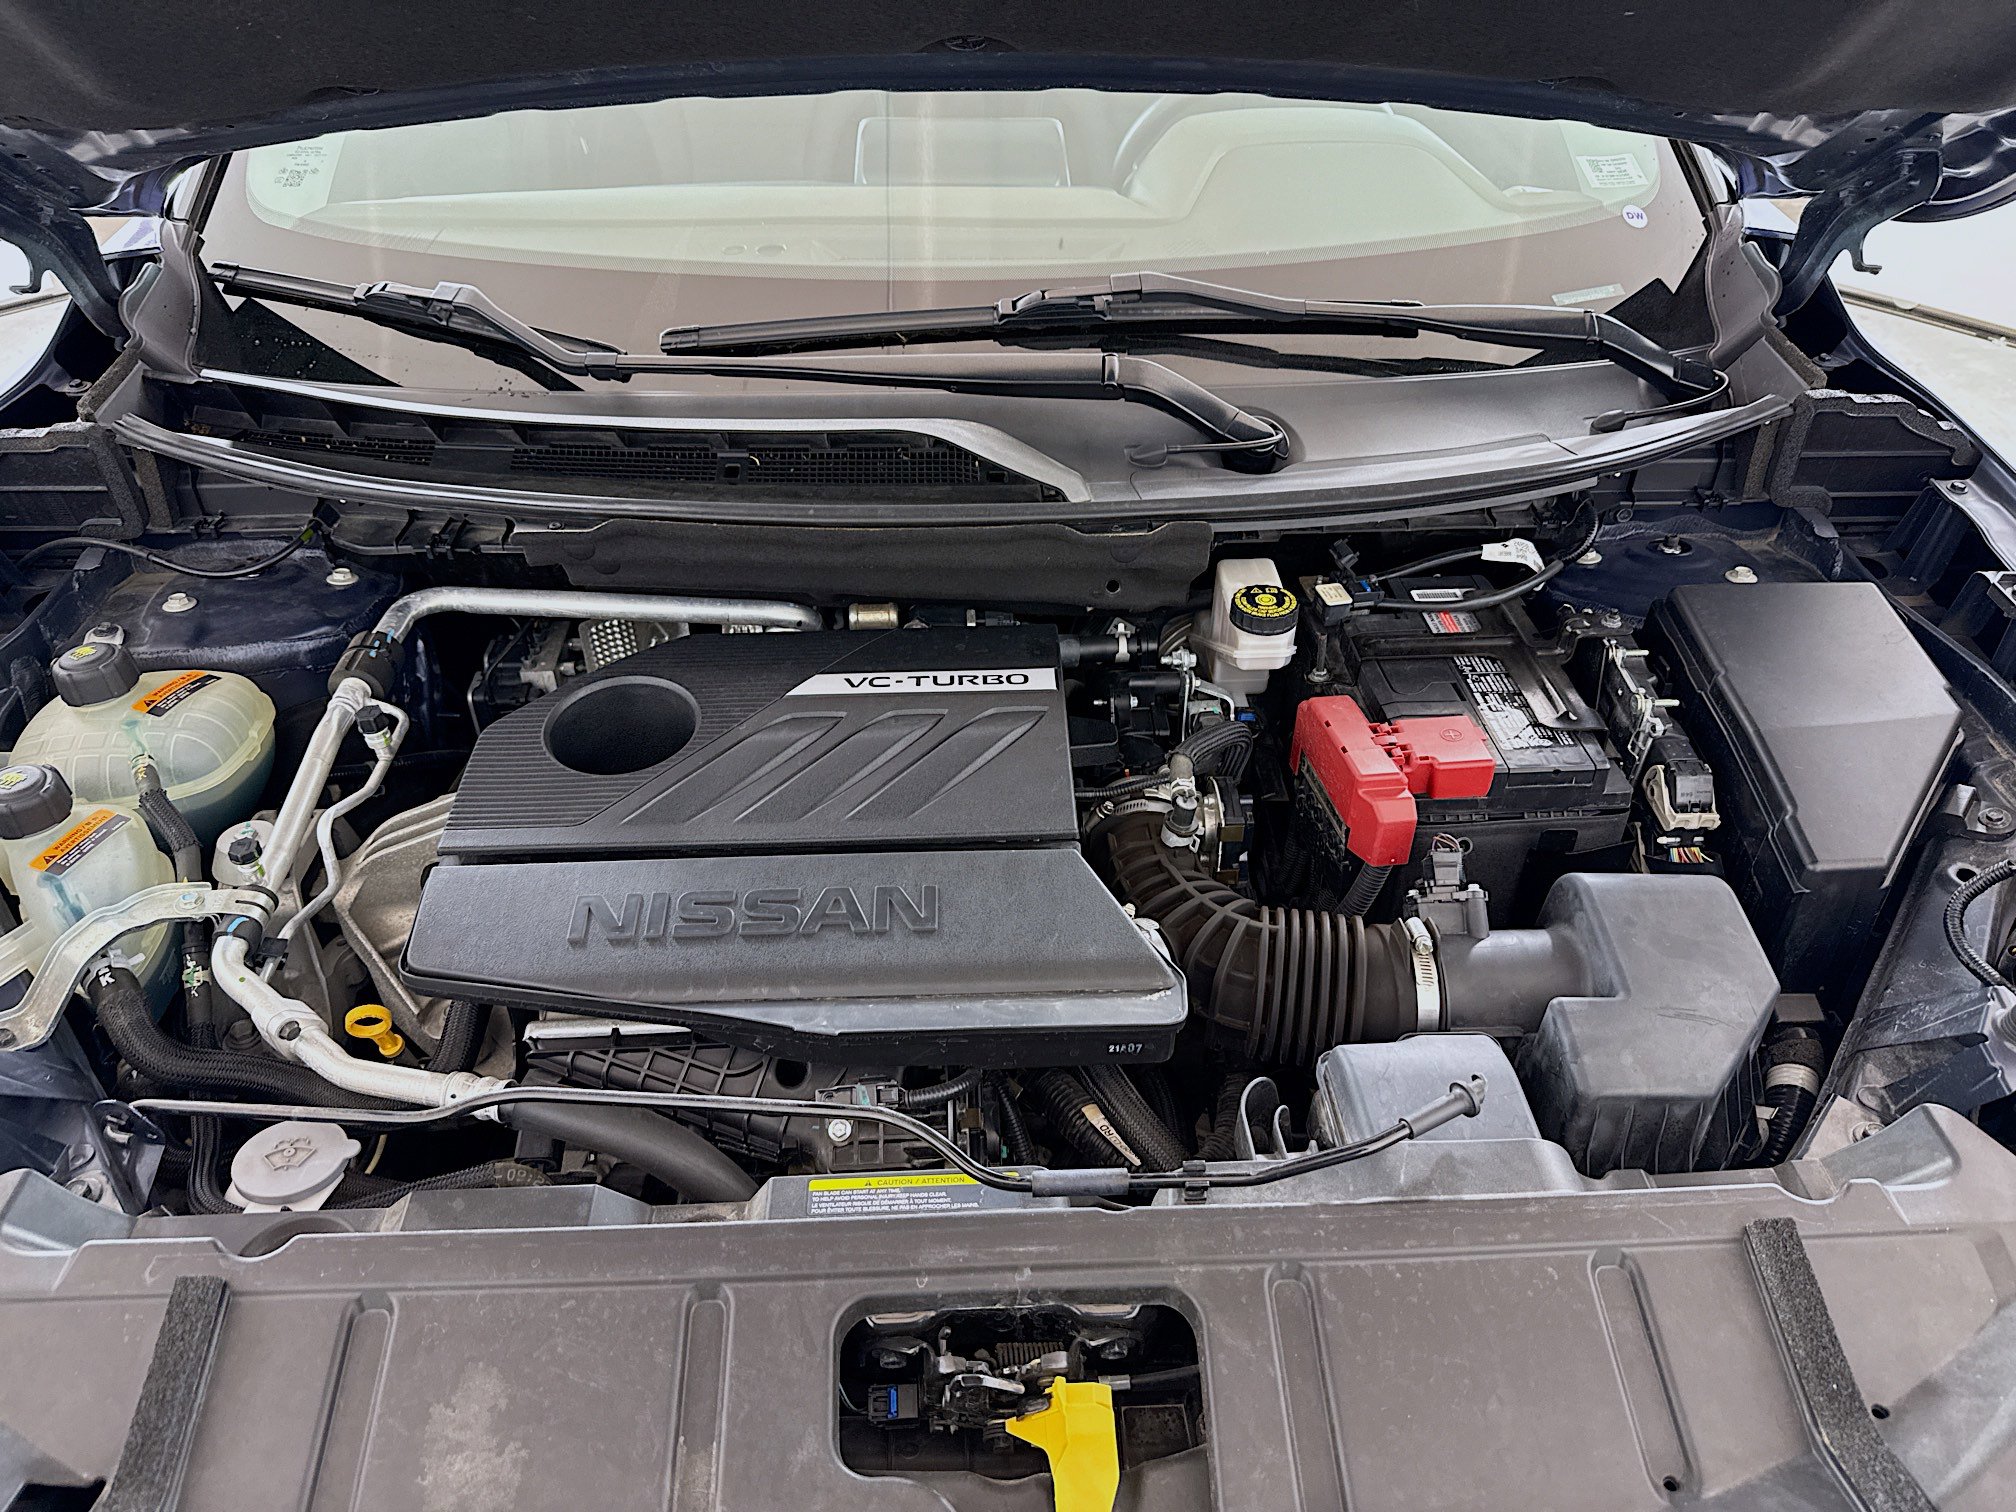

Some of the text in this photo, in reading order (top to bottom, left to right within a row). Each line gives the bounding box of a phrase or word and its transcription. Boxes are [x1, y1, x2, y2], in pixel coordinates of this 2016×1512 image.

[1625, 211, 1644, 220] DW
[843, 673, 1030, 689] VC-TURBO
[53, 828, 83, 851] WARNING
[567, 885, 940, 944] NISSAN
[877, 1178, 913, 1186] CAUTION
[921, 1176, 965, 1185] ATTENTION
